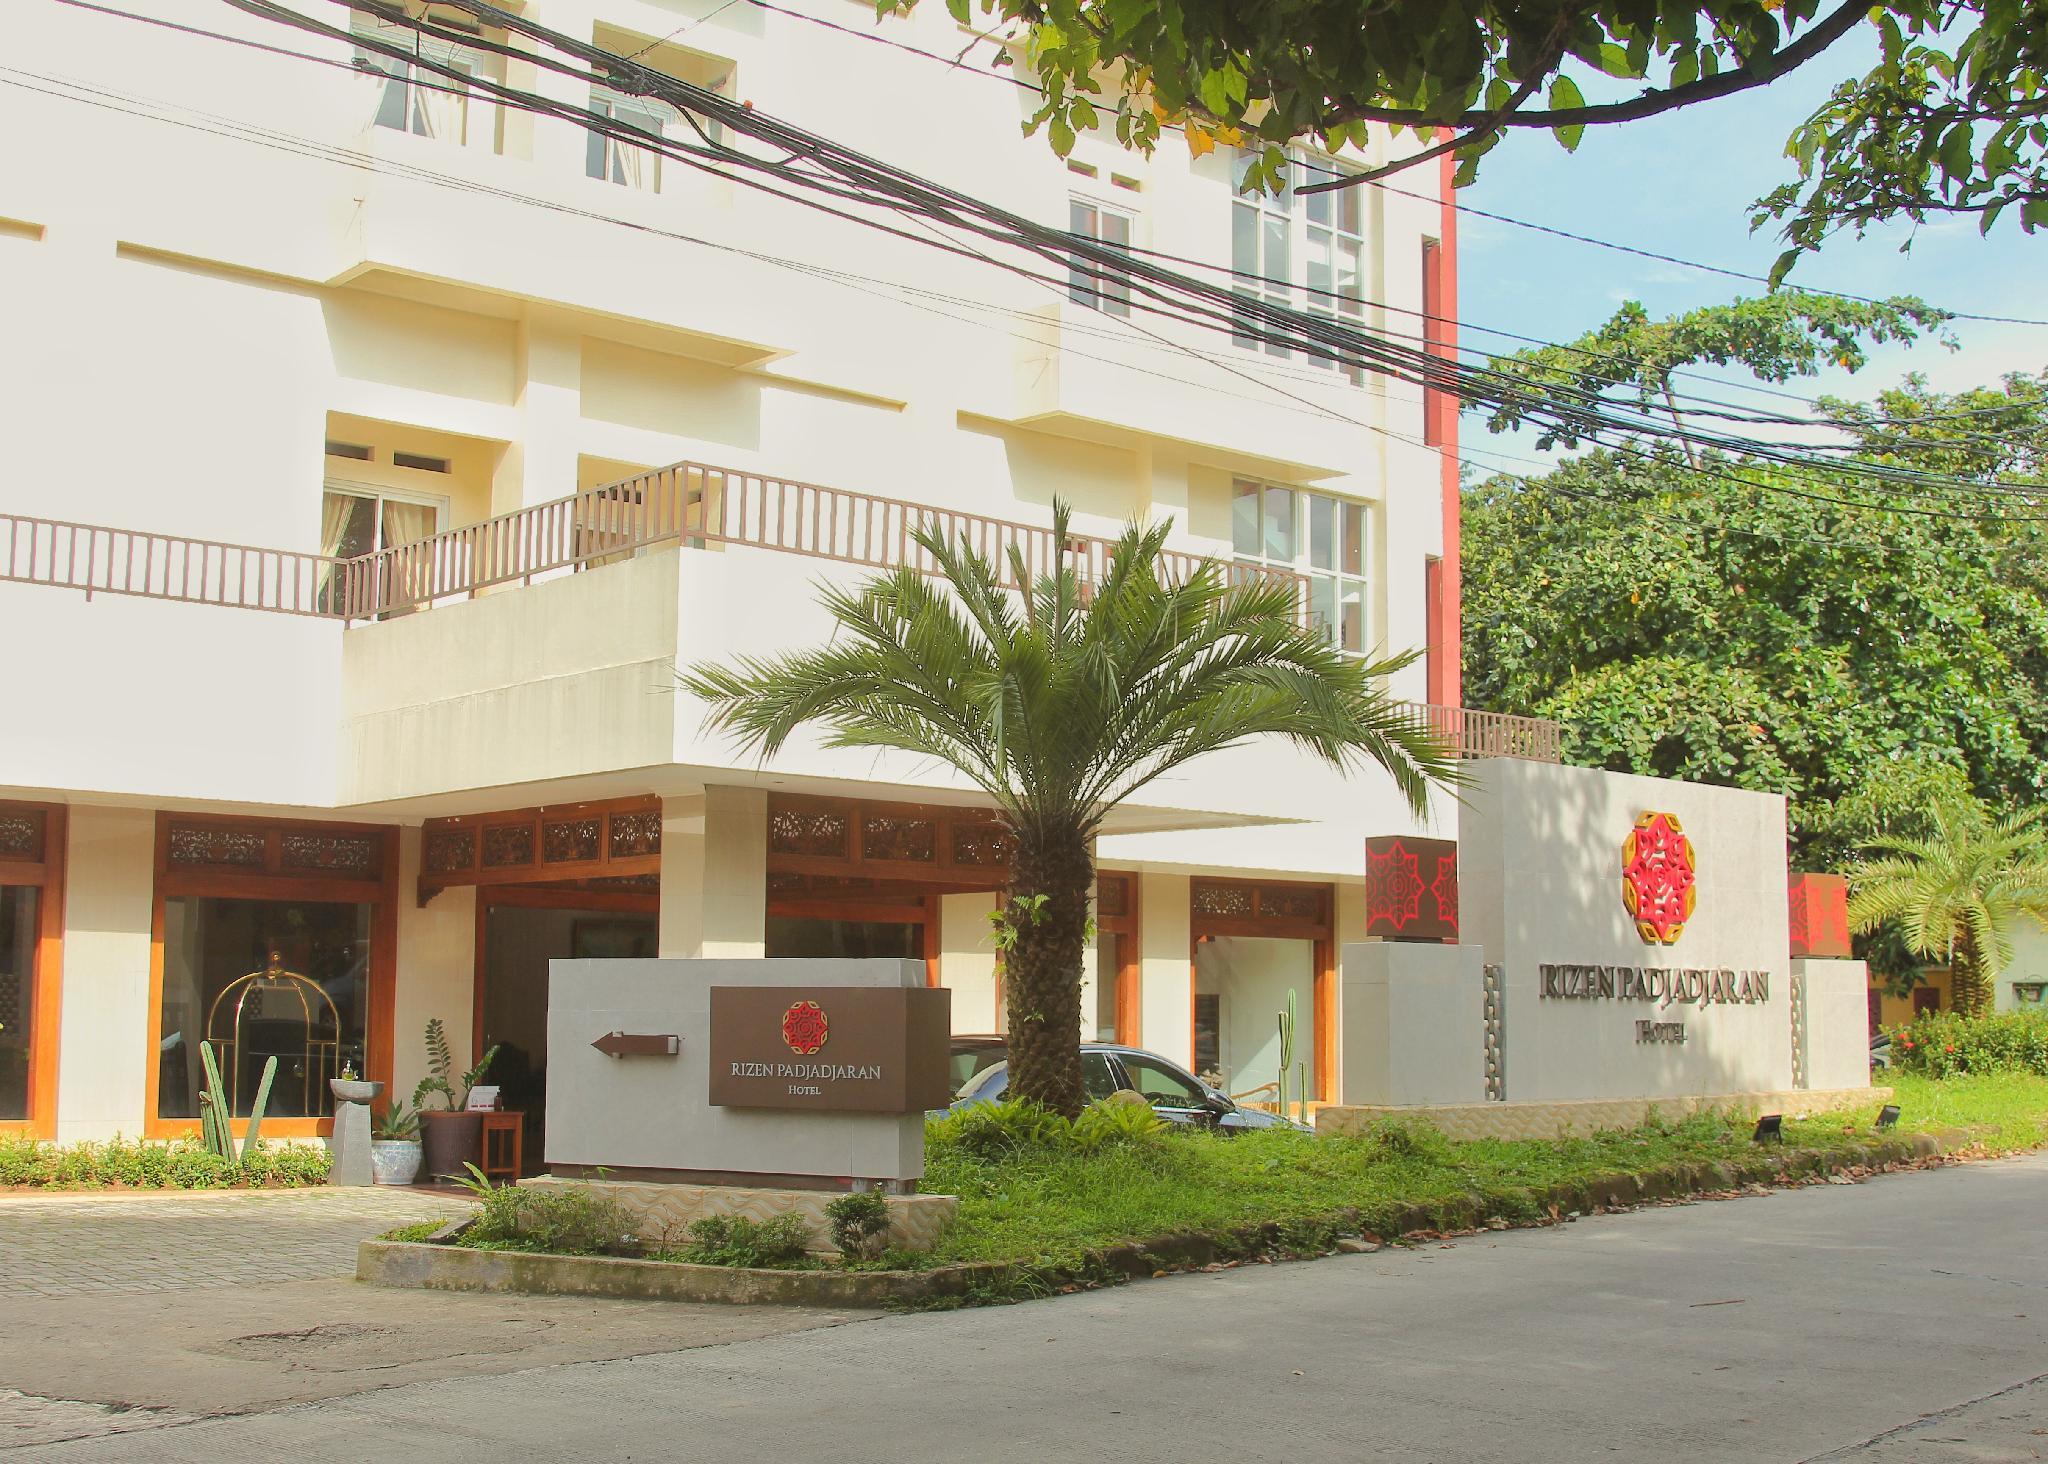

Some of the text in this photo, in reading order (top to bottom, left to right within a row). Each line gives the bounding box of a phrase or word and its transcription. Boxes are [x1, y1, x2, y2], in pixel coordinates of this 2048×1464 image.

[1539, 963, 1770, 1010] RIZEN PADJADJARAN
[731, 1062, 881, 1081] RIZEN PADJADJARAN
[788, 1085, 822, 1095] HOTEL
